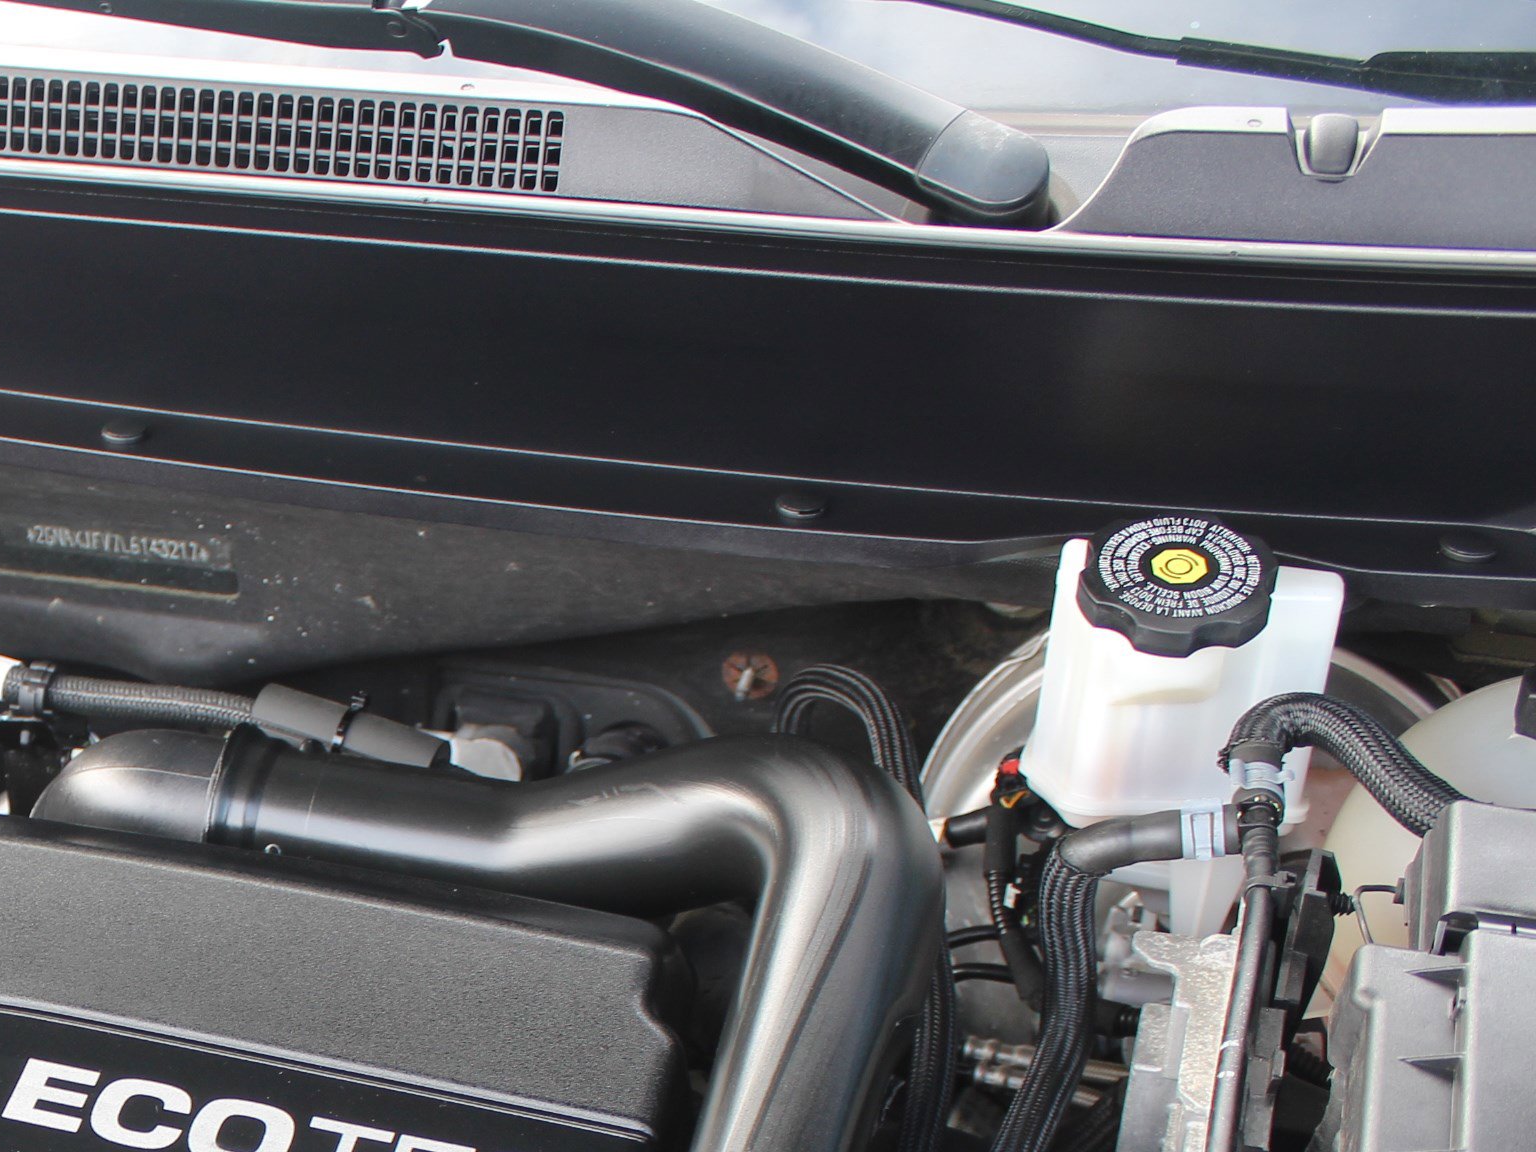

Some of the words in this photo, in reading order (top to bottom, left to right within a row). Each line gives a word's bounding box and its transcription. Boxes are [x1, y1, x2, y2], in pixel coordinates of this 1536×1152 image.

[1153, 517, 1181, 526] FLUID
[1145, 526, 1183, 537] BEFORE
[1185, 526, 1204, 536] CAP
[1100, 533, 1125, 556] SEALED
[1150, 534, 1197, 545] WARNING:
[1209, 524, 1252, 554] ATTENTION:
[1128, 544, 1151, 561] CLEAN
[1199, 540, 1232, 574] PROVENANT
[1113, 558, 1125, 571] USE
[1246, 554, 1261, 586] NETTOYER
[1127, 561, 1144, 583] FILLER
[1115, 571, 1133, 587] ONLY
[1227, 579, 1242, 590] DU
[1183, 586, 1214, 599] BIDON
[1241, 585, 1254, 595] LE
[1154, 596, 1183, 608] FREIN
[1188, 599, 1200, 608] DE
[1202, 588, 1233, 606] LIQUIDE
[1206, 594, 1246, 614] BOUCHON
[1156, 606, 1169, 616] LA
[1172, 608, 1203, 617] AVANT
